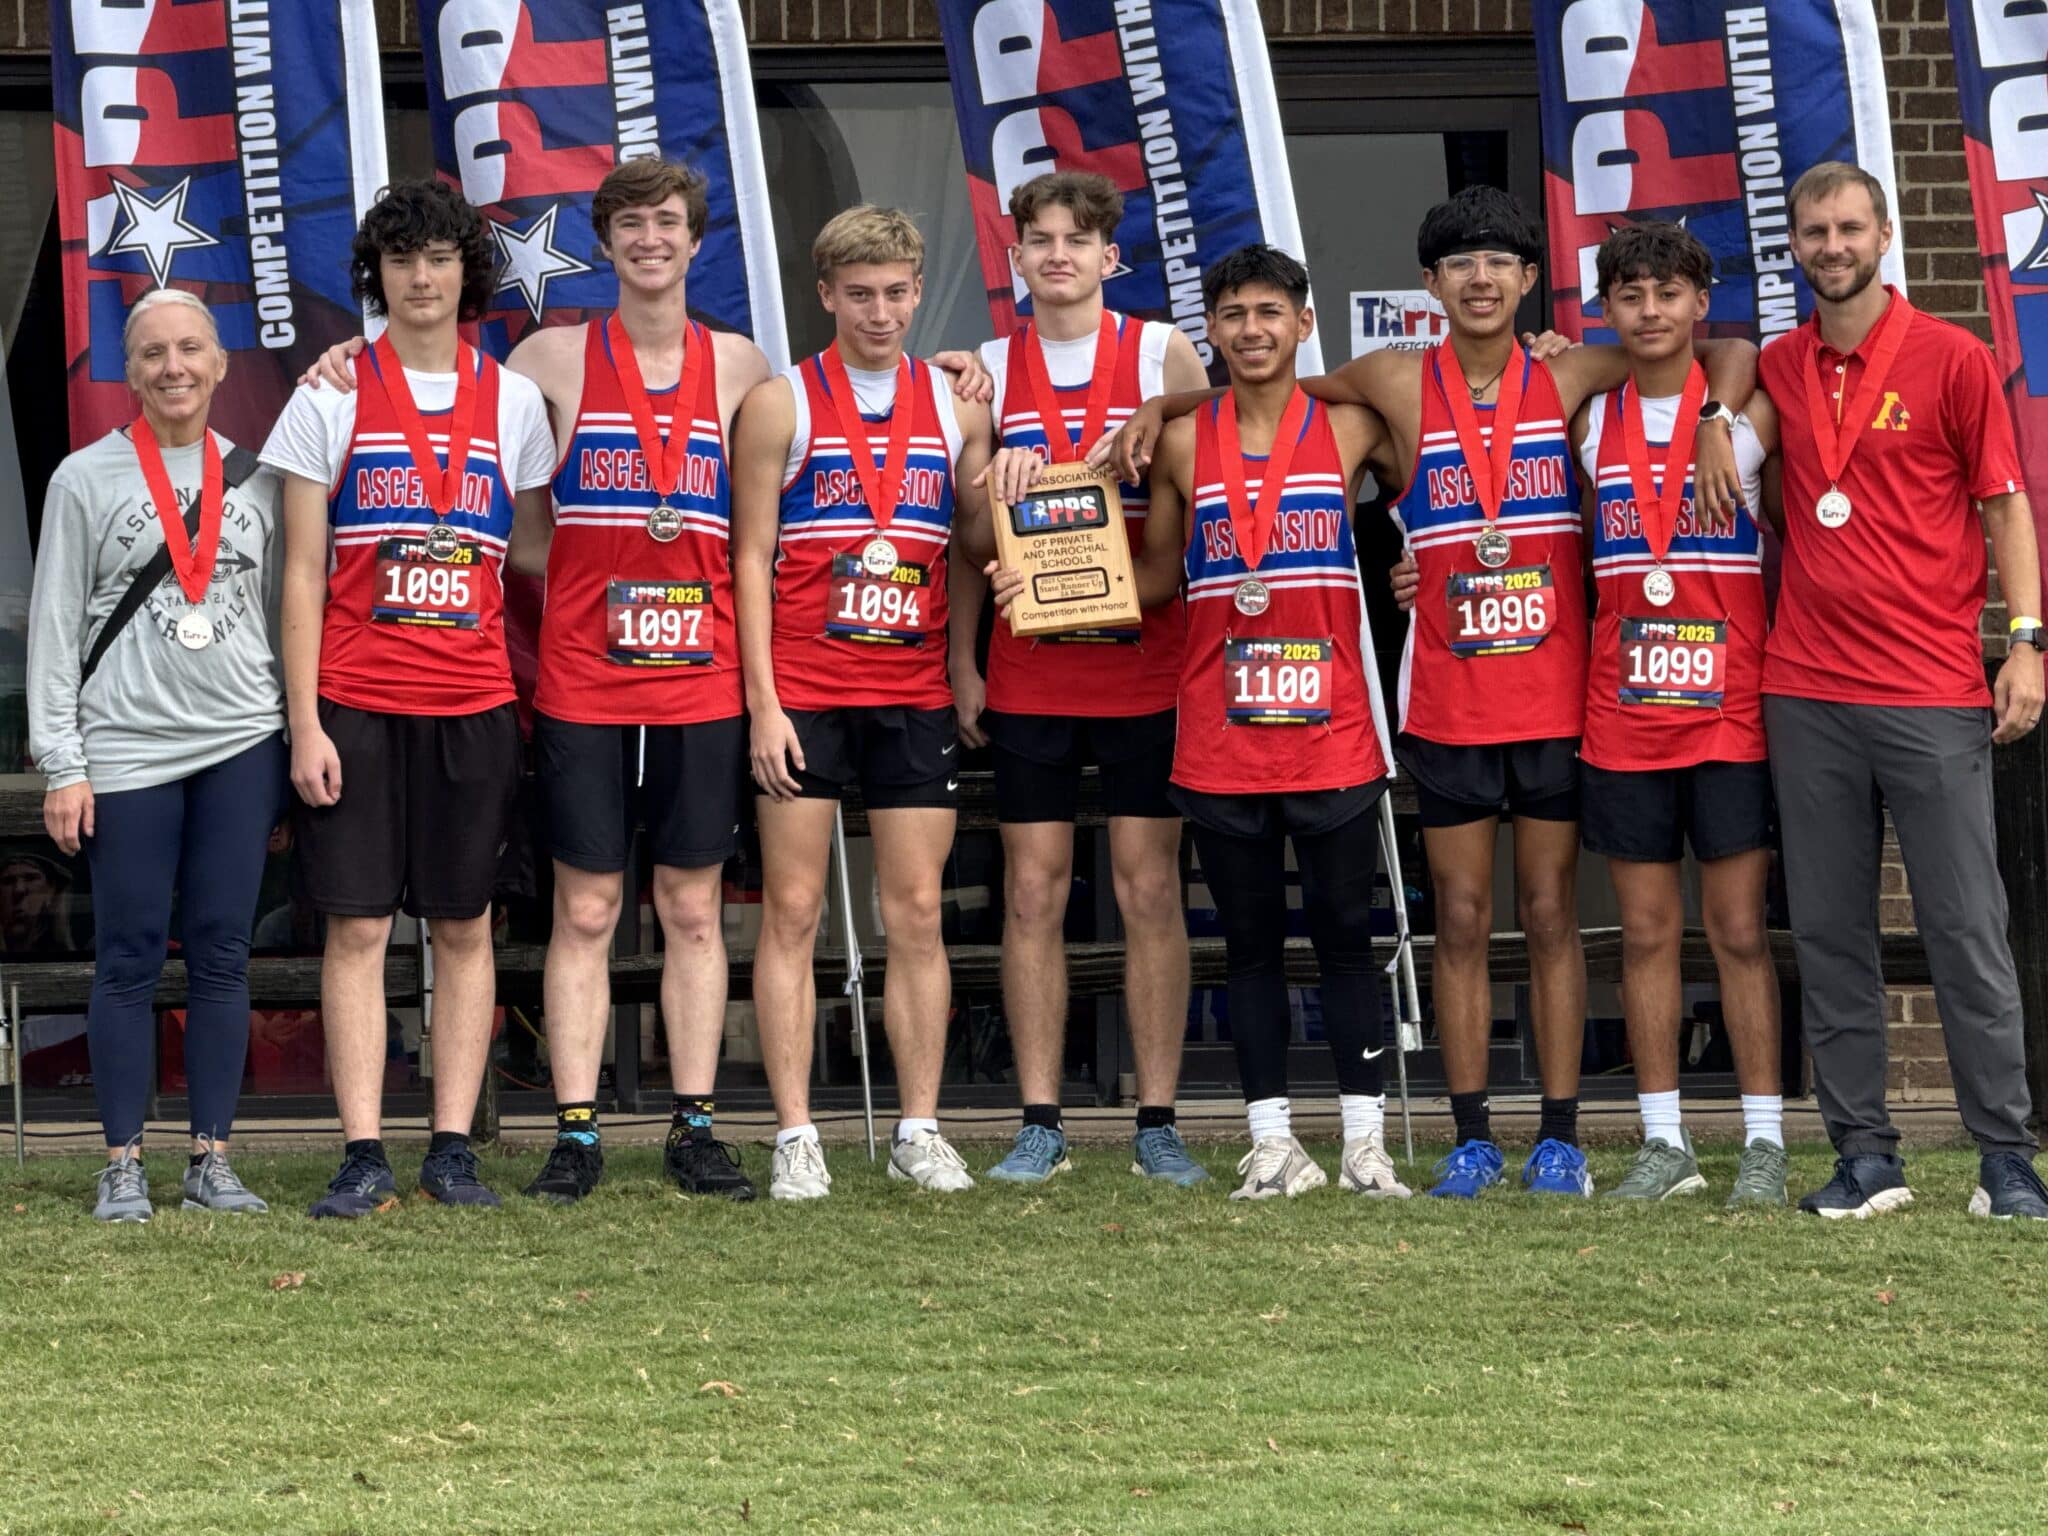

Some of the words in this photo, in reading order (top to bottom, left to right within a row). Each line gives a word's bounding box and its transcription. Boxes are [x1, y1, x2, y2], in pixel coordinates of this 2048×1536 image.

[230, 0, 272, 78] WIT
[606, 3, 655, 112] WITH
[1114, 0, 1166, 106] WITH
[1725, 7, 1775, 117] WITH
[71, 0, 256, 382] TAPP
[237, 84, 296, 349] COMPETITION
[1738, 122, 1799, 350] MPETITION
[1357, 296, 1449, 337] TAPP
[357, 467, 493, 518] ASCEION
[580, 449, 719, 499] ASCEION
[814, 468, 945, 509] ASCSION
[1427, 456, 1567, 510] ASCSION
[116, 488, 251, 551] ASCNON
[1018, 495, 1099, 528] TAPPS
[1023, 549, 1046, 560] AND
[1047, 543, 1108, 557] PAROCHIAL
[1033, 538, 1048, 549] OF
[1050, 533, 1093, 547] PRIVATE
[1202, 509, 1342, 562] ASNSION
[890, 566, 921, 585] 2025
[1041, 555, 1093, 569] SCHOOLS
[1459, 576, 1504, 594] TAPPS
[1504, 571, 1543, 591] 2025
[384, 566, 470, 607] 1095
[621, 587, 666, 604] TAPPS
[666, 587, 704, 604] 2025
[837, 582, 920, 627] 1094
[618, 608, 705, 647] 1097
[1021, 605, 1078, 621] Competition
[1079, 603, 1099, 616] with
[1101, 600, 1129, 614] Honor
[1458, 593, 1546, 636] 1096
[1283, 645, 1321, 661] 2025
[1676, 624, 1716, 642] 2025
[1234, 665, 1321, 704] 1100
[1628, 645, 1714, 686] 1099
